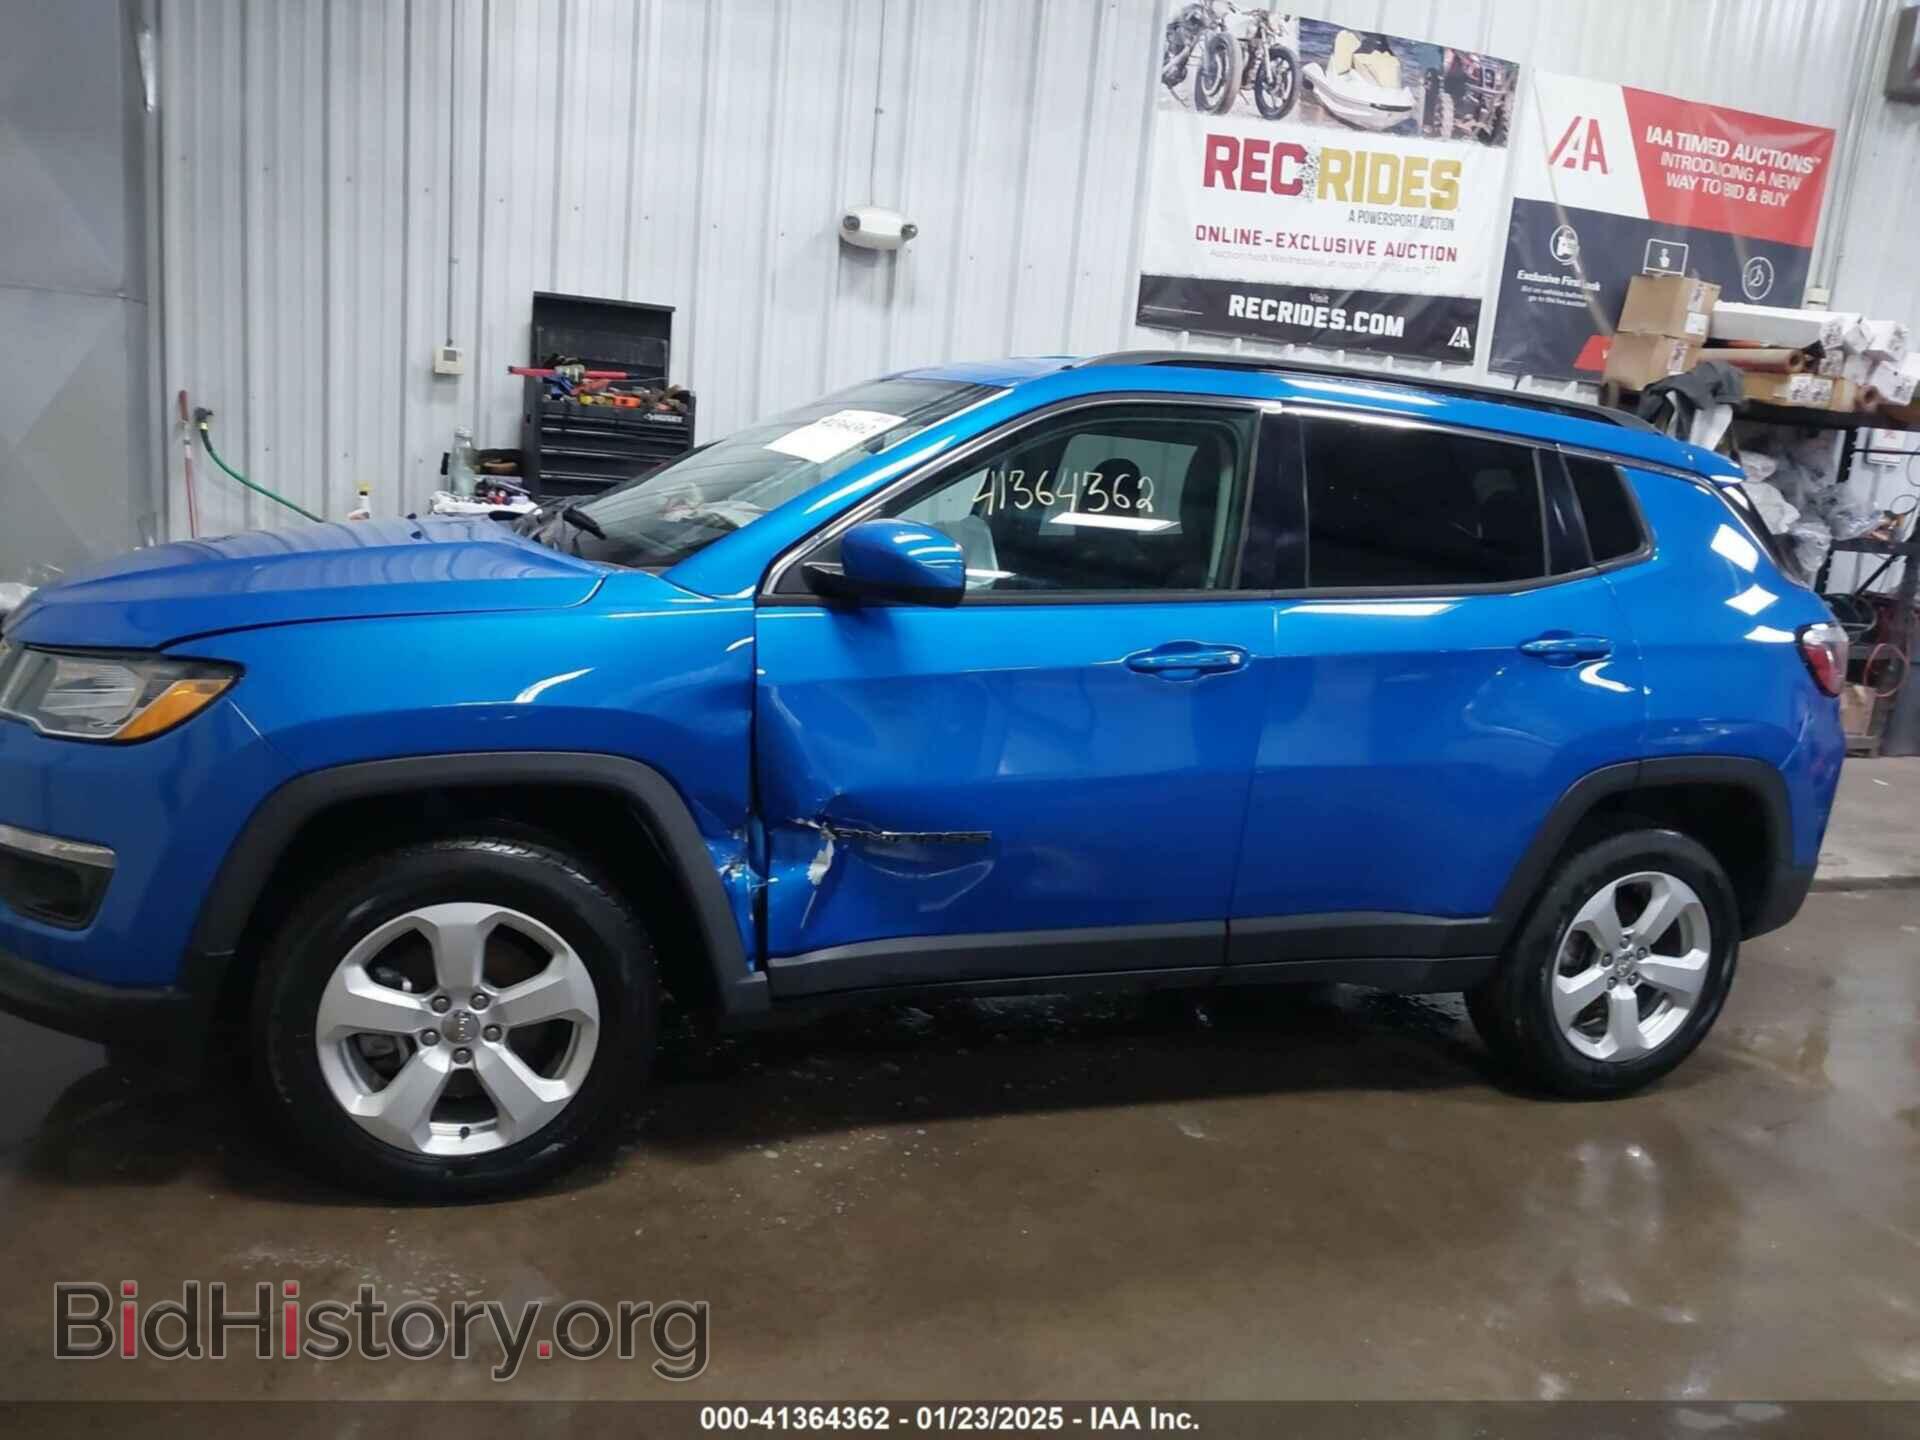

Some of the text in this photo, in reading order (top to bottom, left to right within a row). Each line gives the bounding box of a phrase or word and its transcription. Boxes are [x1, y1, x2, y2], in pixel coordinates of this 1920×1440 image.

[1646, 125, 1673, 148] IAA
[1676, 132, 1730, 157] TIMED
[1203, 133, 1462, 211] REC RIDES
[1660, 152, 1803, 191] INTRODUCING A NEW
[1666, 172, 1790, 207] WAY TO BID & BUY
[1348, 209, 1355, 222] A
[1358, 209, 1418, 228] POWERSPORT
[1195, 224, 1377, 256] ONLINE-EXCLUSIVE
[1384, 242, 1458, 262] AUCTION
[1228, 294, 1405, 338] RECRIDES.COM
[973, 466, 1155, 516] 41364362
